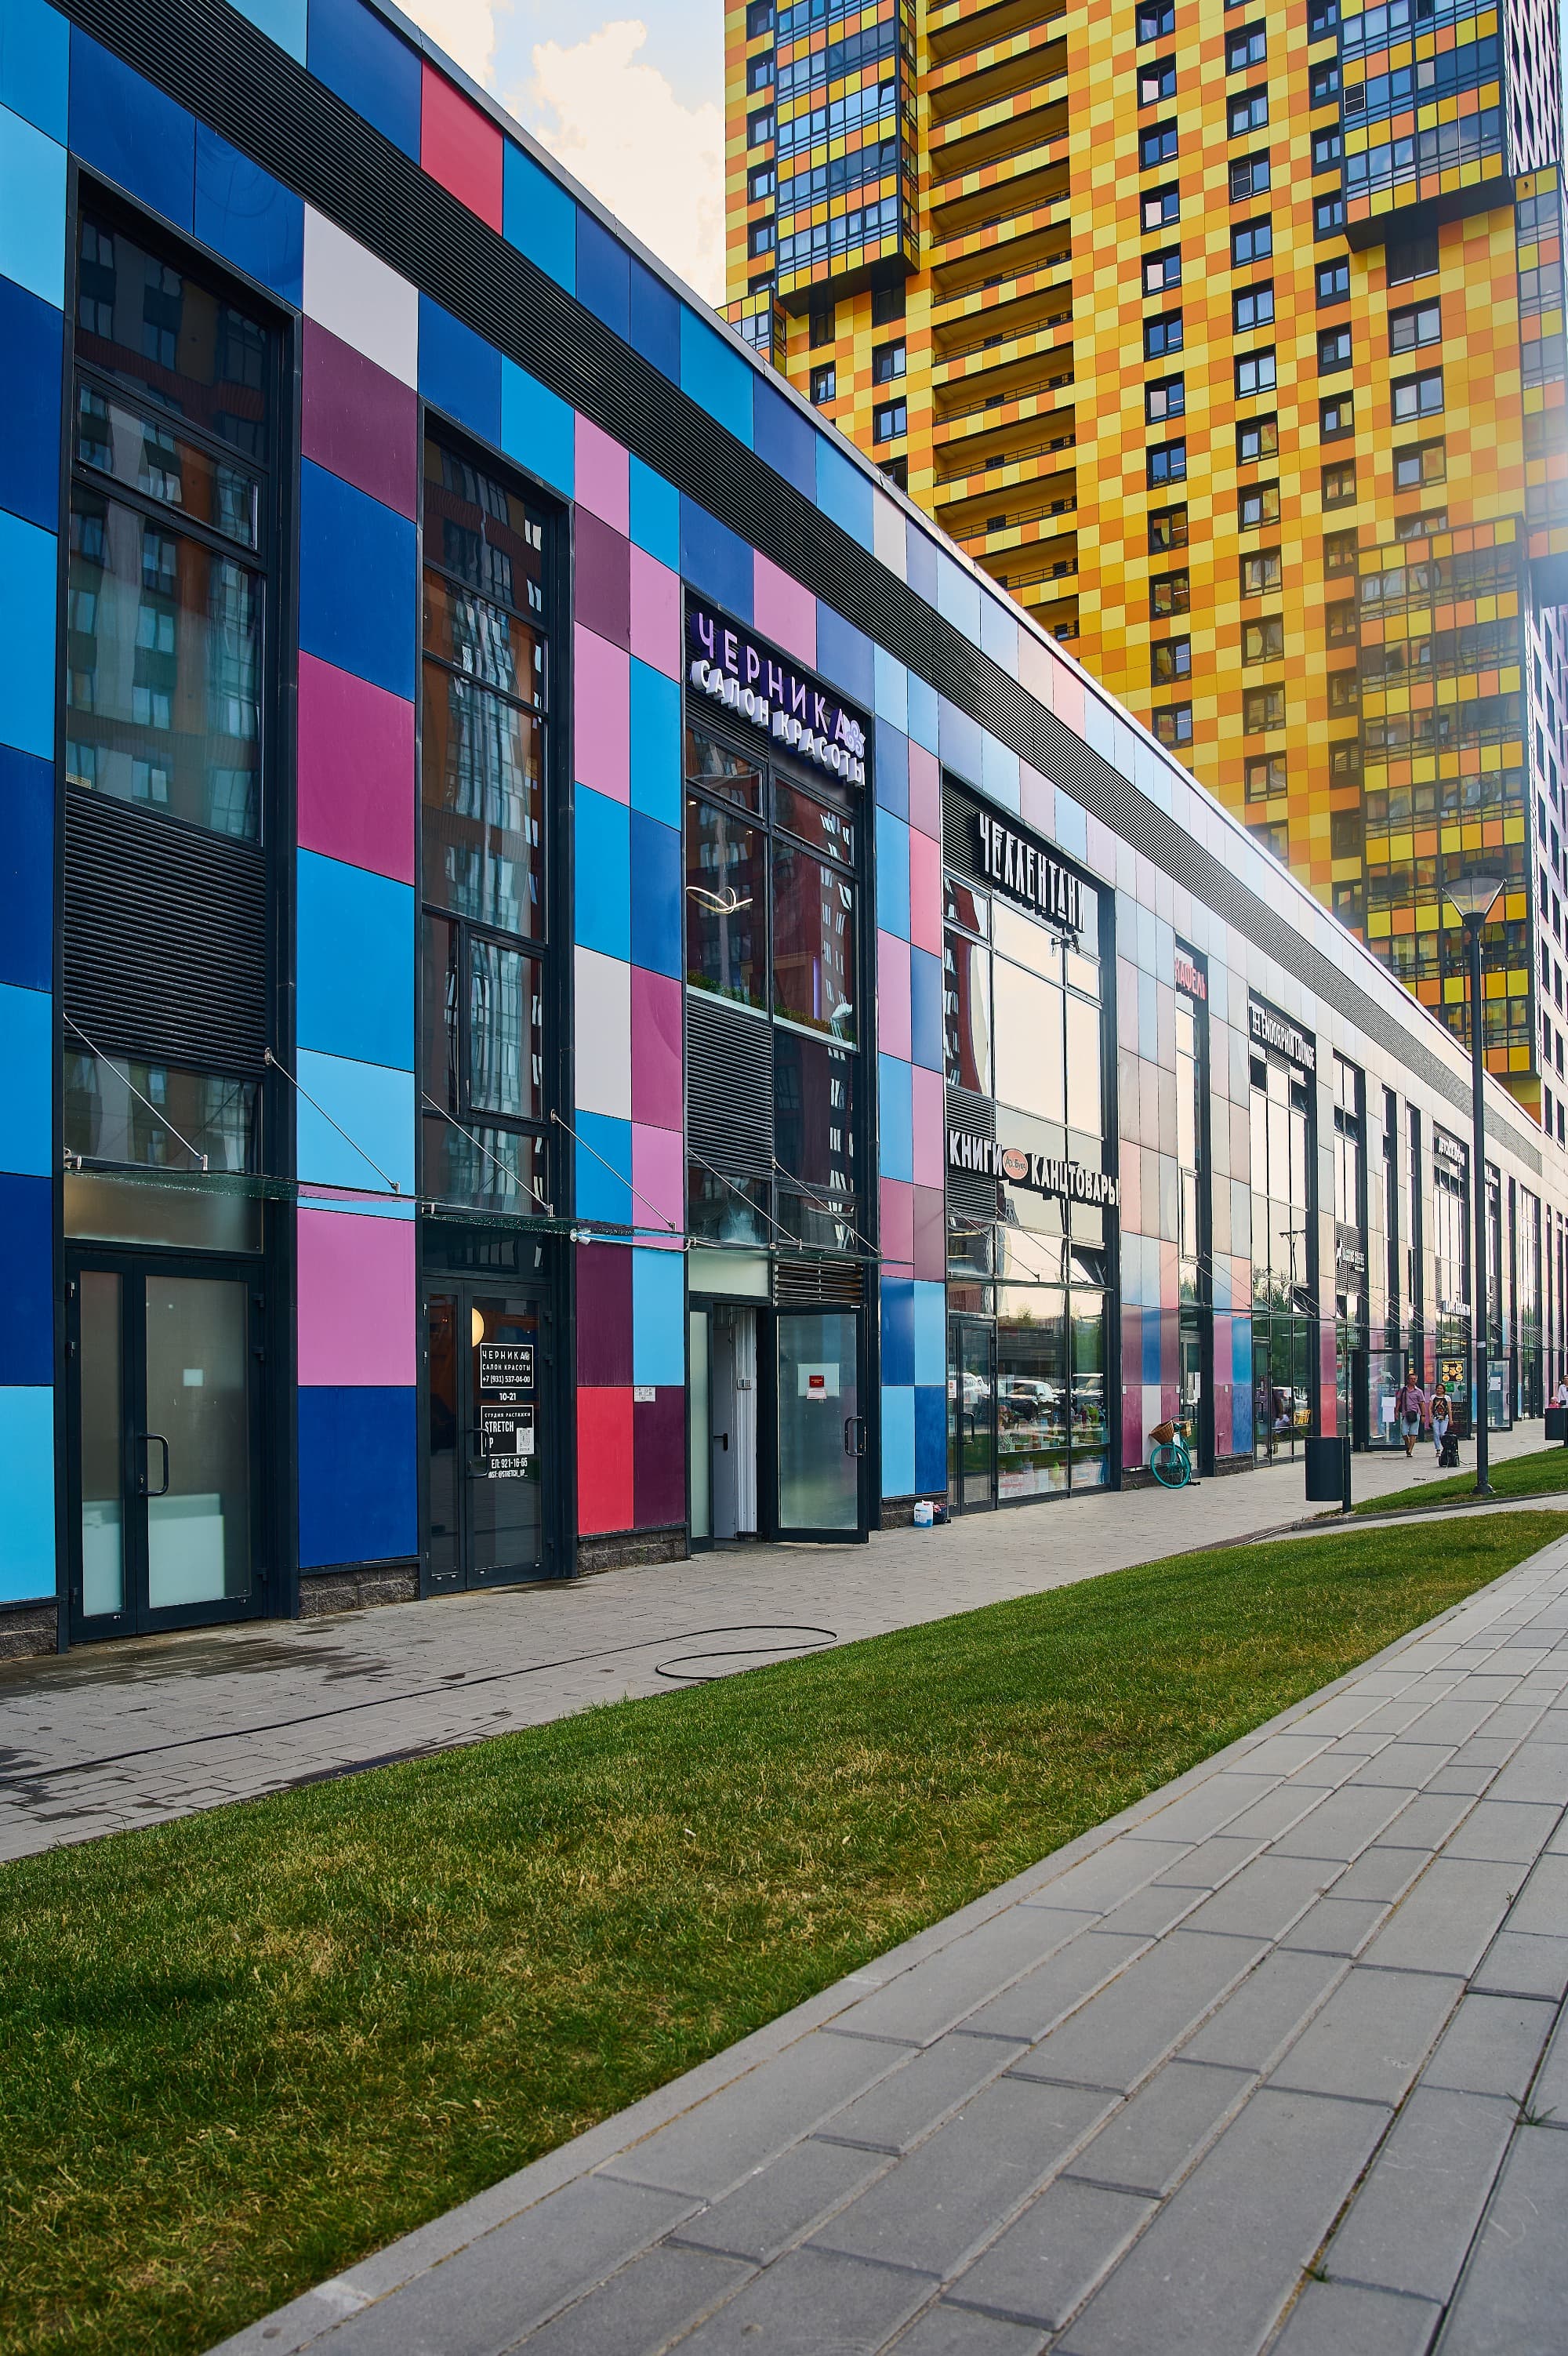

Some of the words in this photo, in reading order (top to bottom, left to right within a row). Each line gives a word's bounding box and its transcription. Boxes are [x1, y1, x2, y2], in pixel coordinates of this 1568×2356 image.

[691, 612, 847, 742] ЧЕРНИКА
[691, 659, 768, 728] САЛОН
[772, 710, 865, 786] КРАСОТЫ
[1174, 957, 1206, 1000] КАФЕЛЬ
[1261, 1015, 1294, 1057] ENDORPHIN
[1295, 1034, 1315, 1071] LOUNGE
[949, 1130, 1003, 1176] КНИГИ
[1031, 1153, 1120, 1207] КАНЦТОВАРЫ
[482, 1350, 526, 1360] ЧЕРНИКА
[490, 1375, 504, 1384] (931)
[499, 1392, 517, 1401] 10-21
[485, 1421, 514, 1433] STRETCH
[501, 1458, 528, 1468] 921-16-65
